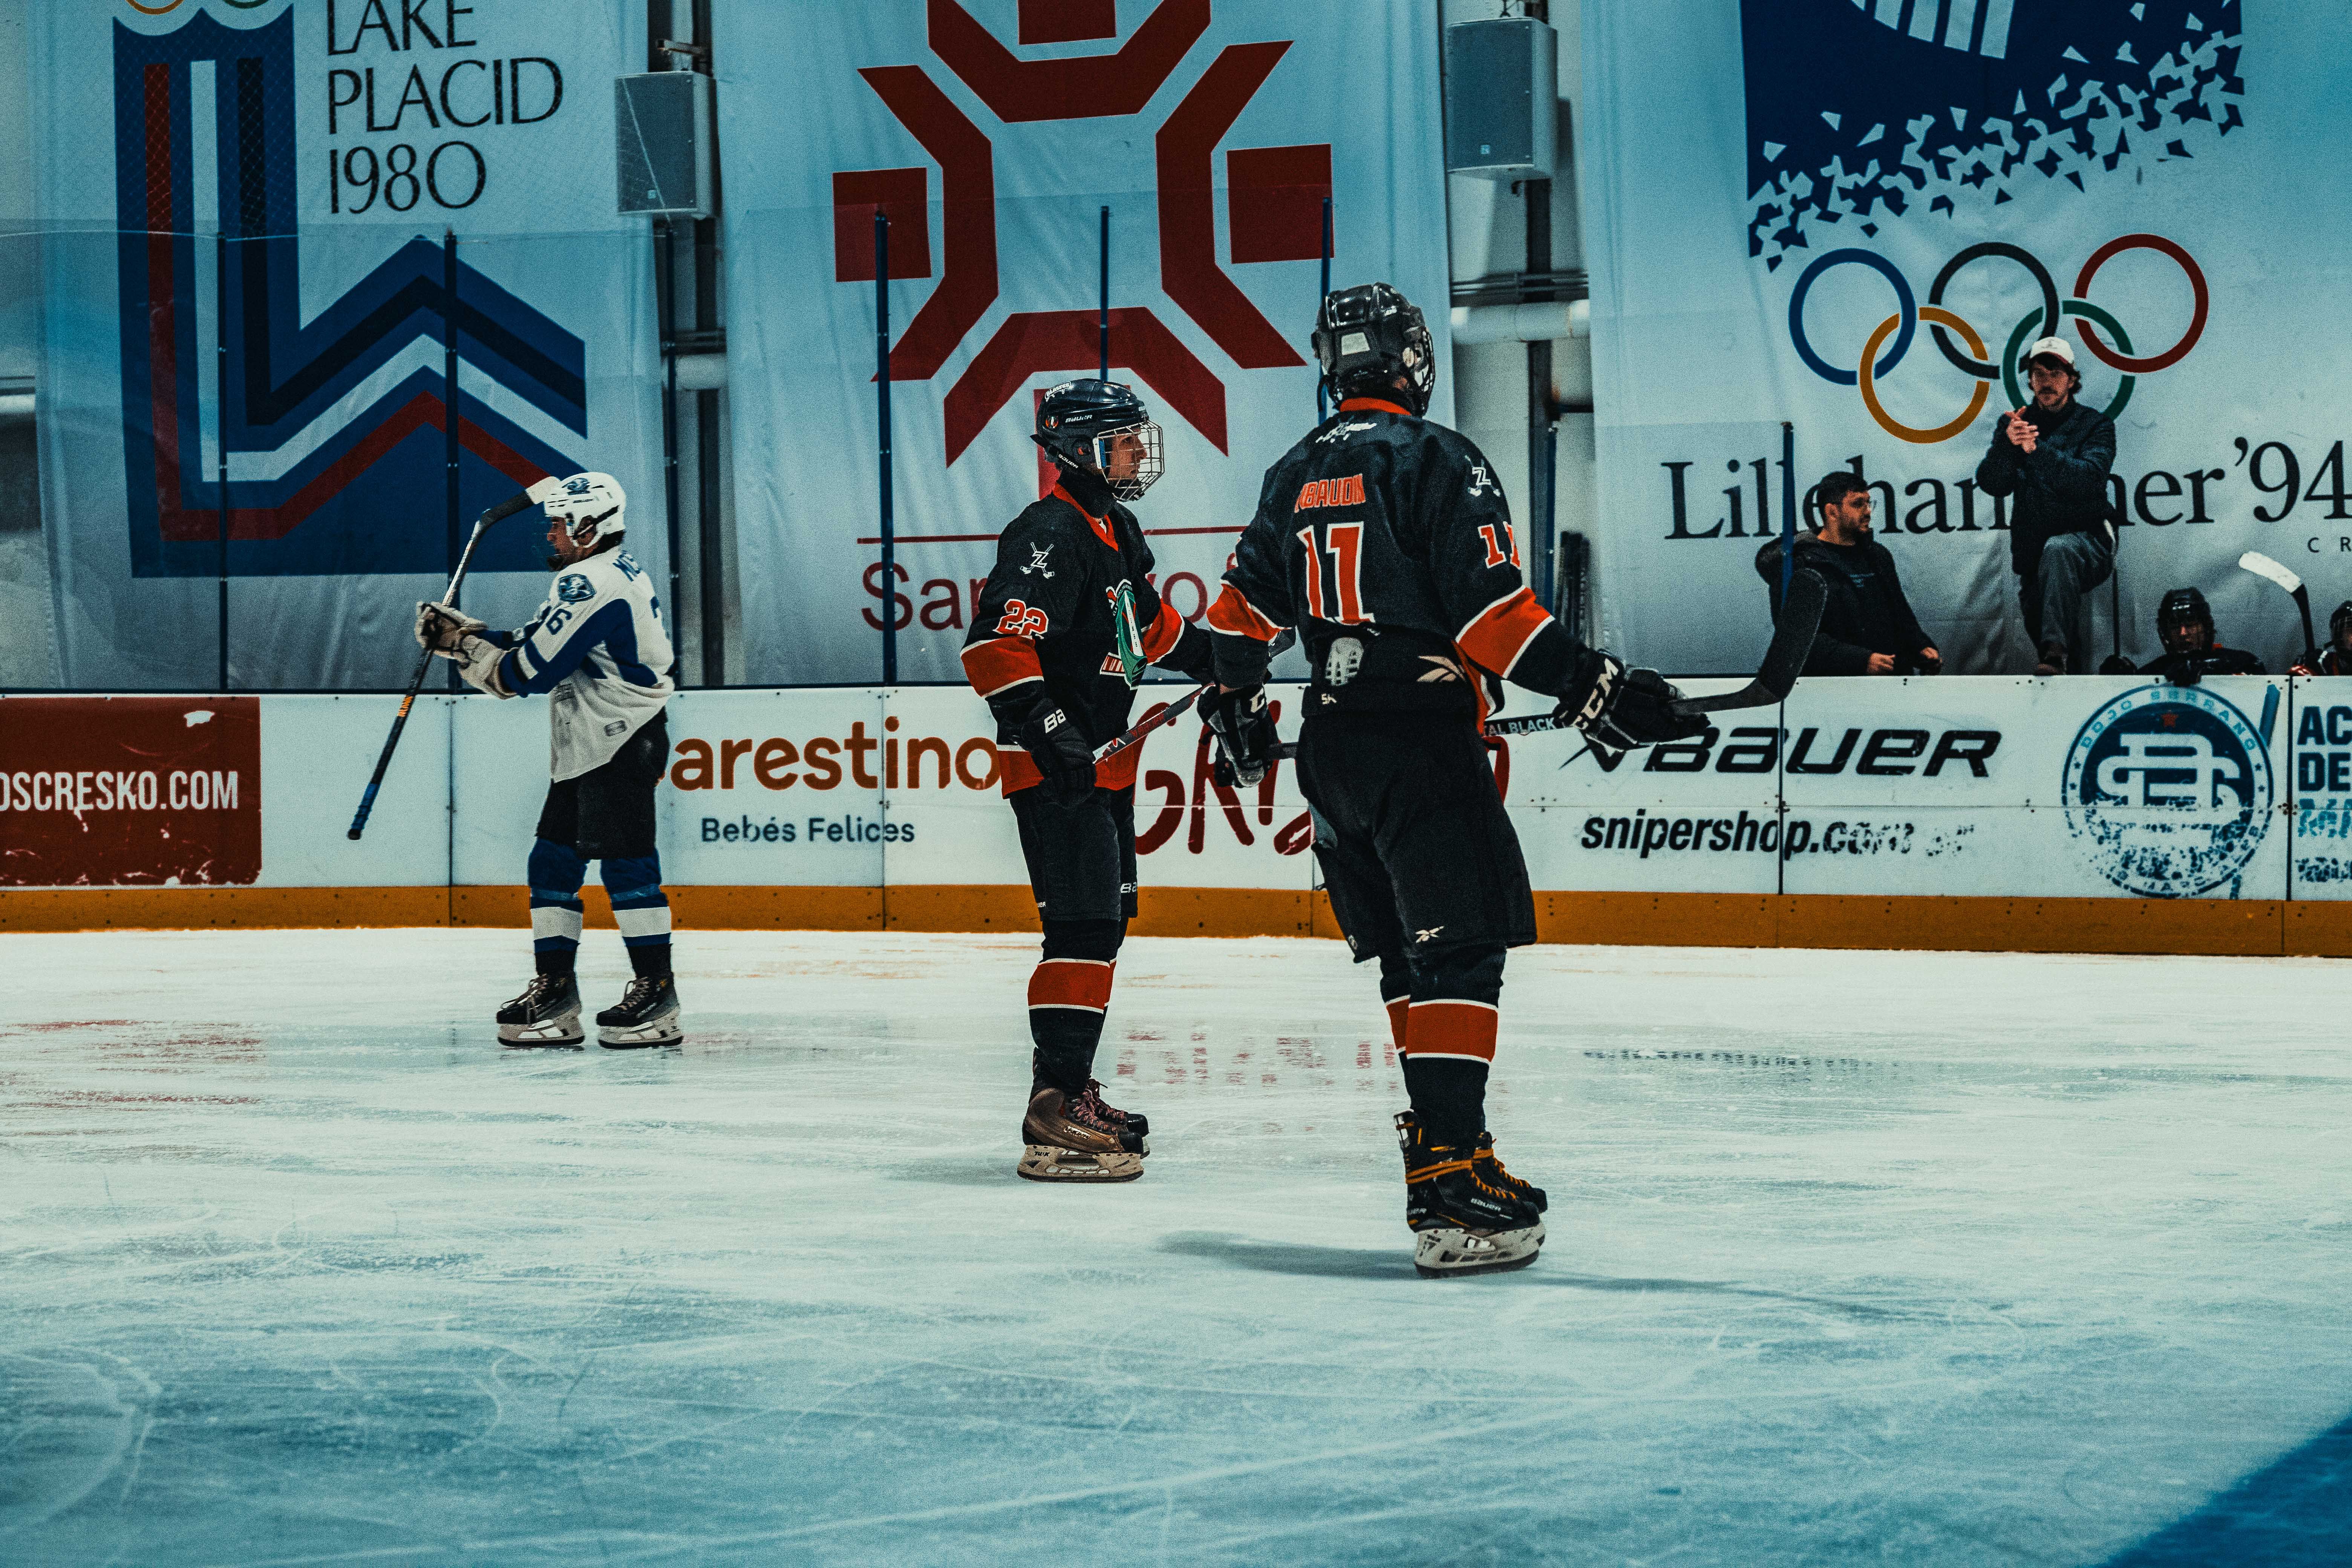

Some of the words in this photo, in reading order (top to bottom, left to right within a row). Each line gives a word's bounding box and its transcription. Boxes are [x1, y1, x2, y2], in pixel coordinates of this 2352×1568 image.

[327, 0, 476, 55] LAKE
[327, 57, 563, 135] PLACID
[329, 141, 486, 214] 1980
[1296, 521, 1375, 626] 11
[1477, 521, 1522, 569] 11
[992, 599, 1049, 640] 22
[1508, 717, 1556, 733] BLACK
[1570, 658, 1619, 730] CCM
[655, 716, 1001, 791] arestino
[701, 814, 796, 842] Bebés
[808, 814, 915, 842] Felices
